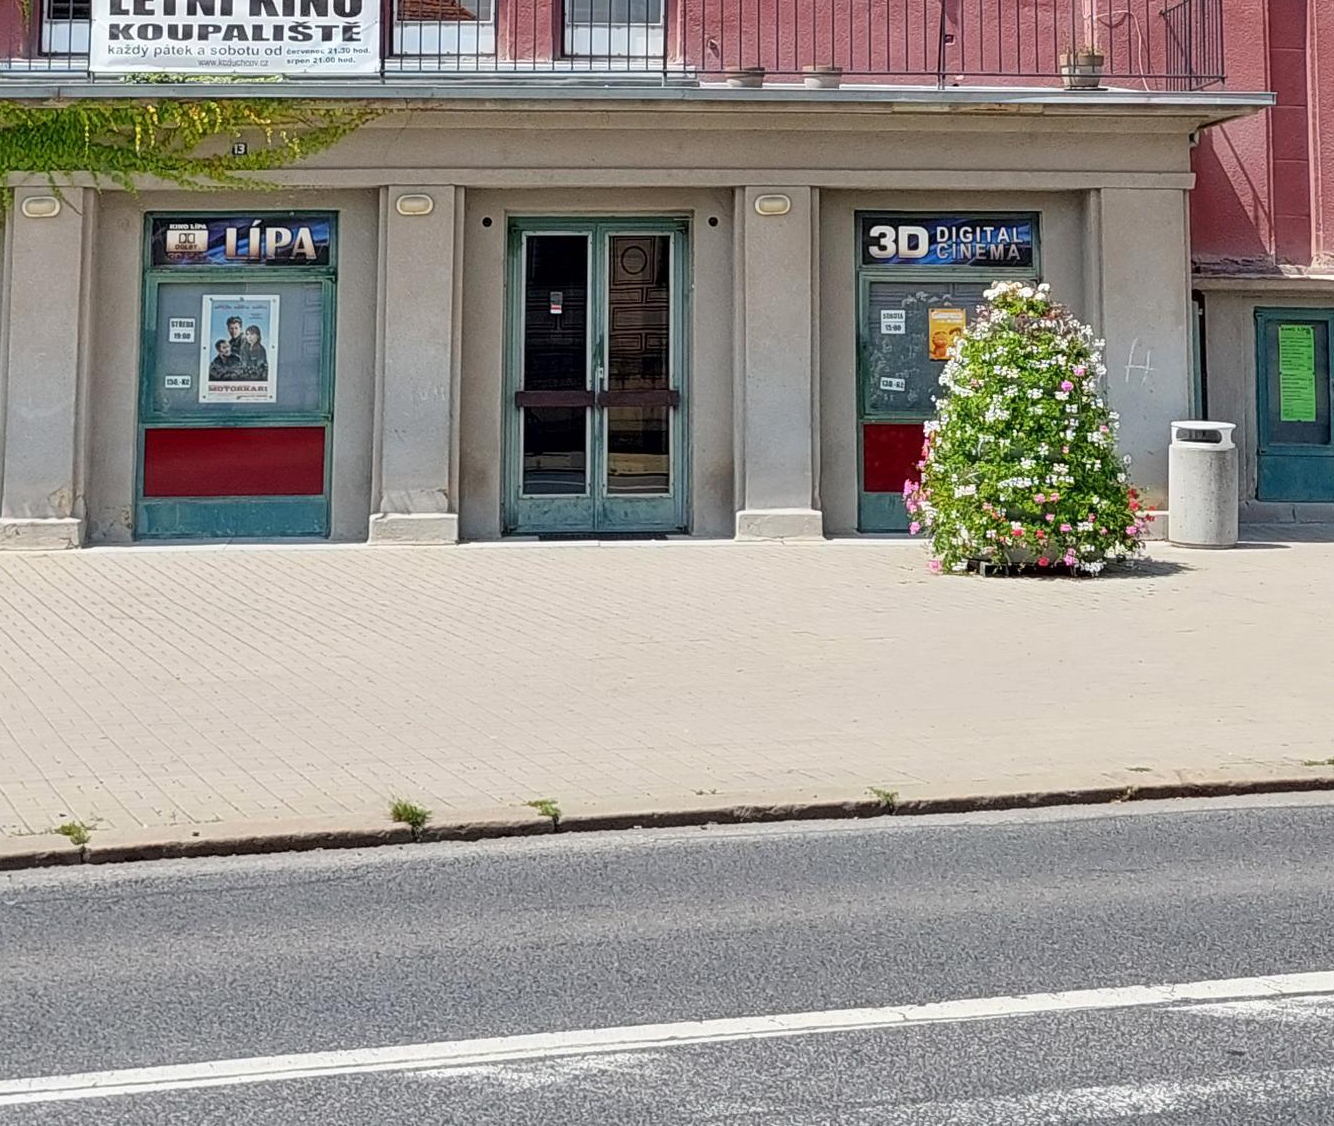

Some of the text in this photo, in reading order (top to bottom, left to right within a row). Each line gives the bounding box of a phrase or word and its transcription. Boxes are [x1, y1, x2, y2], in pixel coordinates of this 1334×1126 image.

[108, 21, 361, 42] KOUPALIŠTĚ
[108, 44, 283, 58] každý pátek a sobotu od
[225, 219, 317, 260] LÍPA
[868, 225, 929, 259] 3D
[936, 226, 1023, 243] DIGITAL
[936, 243, 1021, 260] CINEMA
